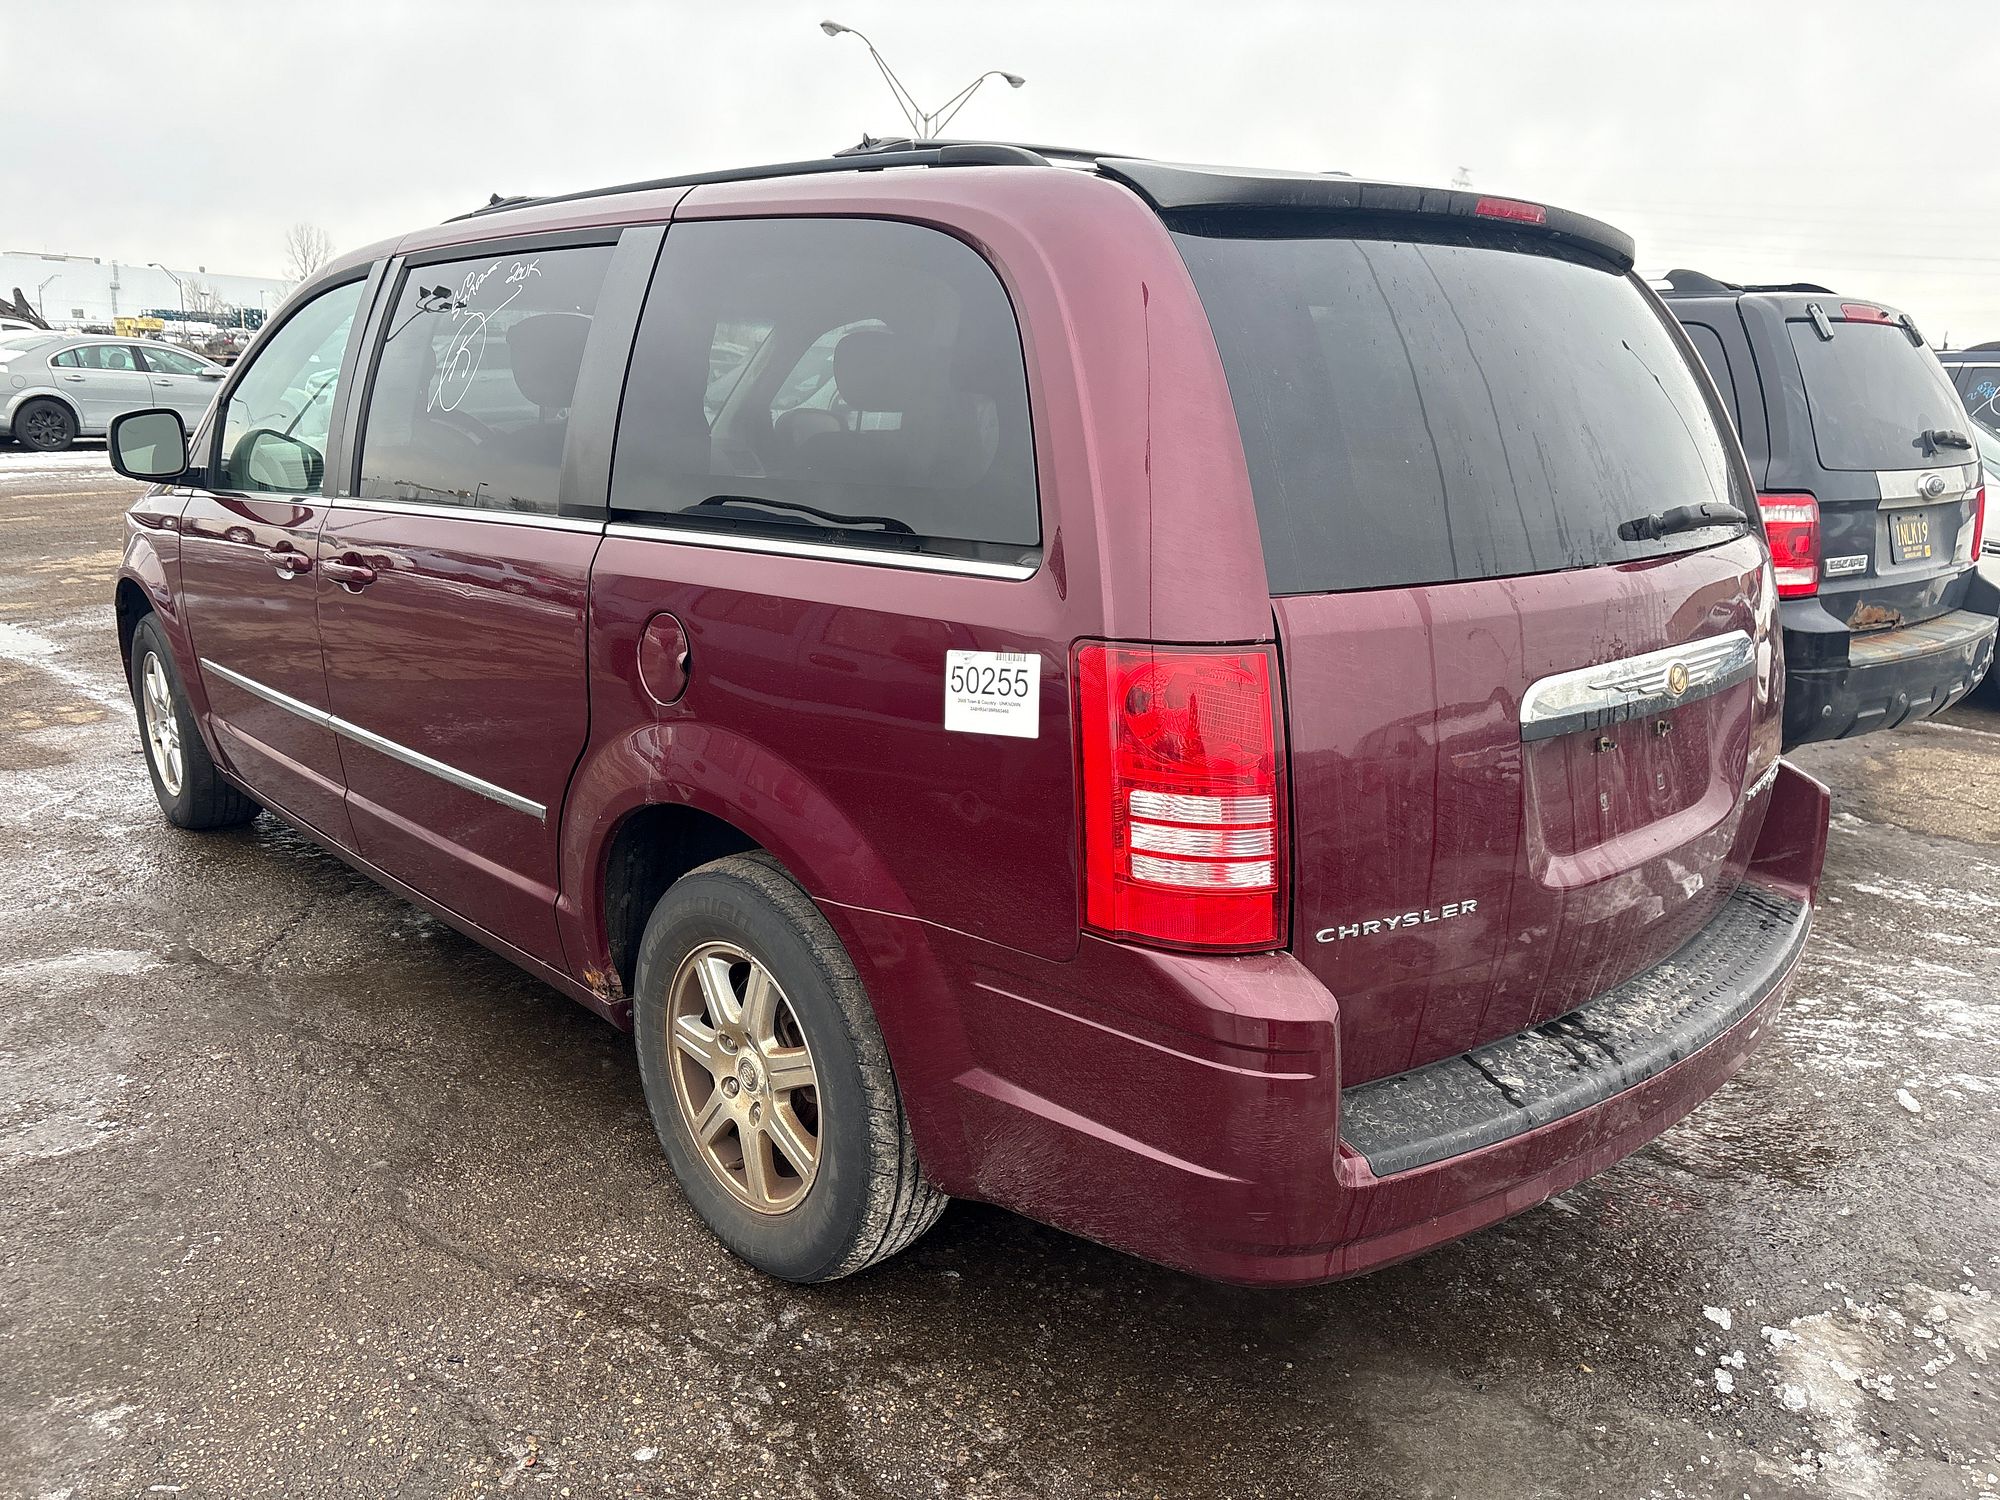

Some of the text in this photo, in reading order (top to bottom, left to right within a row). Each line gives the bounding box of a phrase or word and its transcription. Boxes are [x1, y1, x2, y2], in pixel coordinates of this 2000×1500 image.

[1829, 556, 1867, 570] ESCAPE
[950, 665, 1028, 698] 50255
[1315, 899, 1478, 944] CHRYSLER
